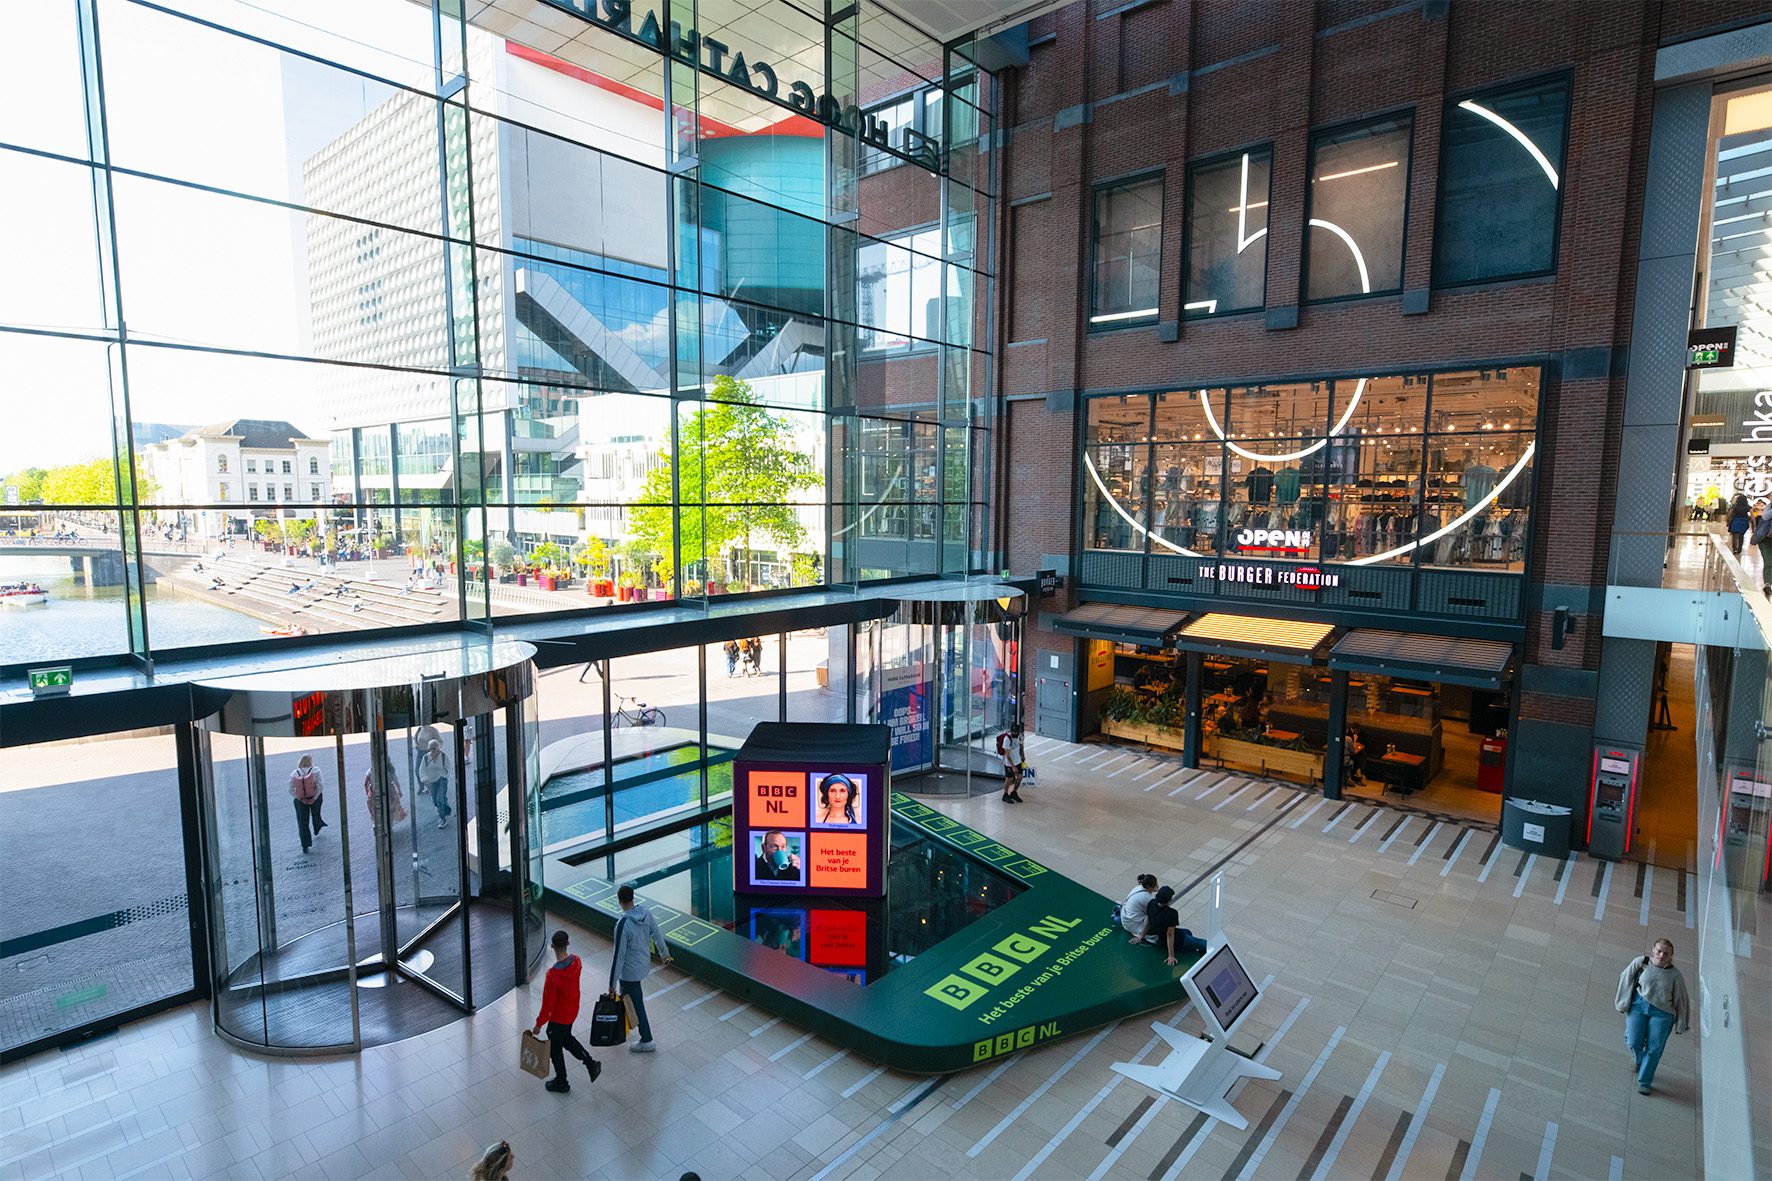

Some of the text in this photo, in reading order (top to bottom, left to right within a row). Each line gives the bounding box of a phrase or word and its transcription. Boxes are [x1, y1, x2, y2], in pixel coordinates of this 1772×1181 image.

[1199, 565, 1339, 587] THE BURGER FEDERATION
[758, 786, 797, 797] BBC
[766, 800, 788, 814] NL
[836, 848, 856, 857] beste
[842, 857, 849, 867] je
[816, 865, 861, 874] Britse buren
[927, 915, 1083, 1009] BBC NL
[978, 927, 1112, 1024] Het beste van je Britse buren
[974, 1021, 1062, 1062] BBC NL
